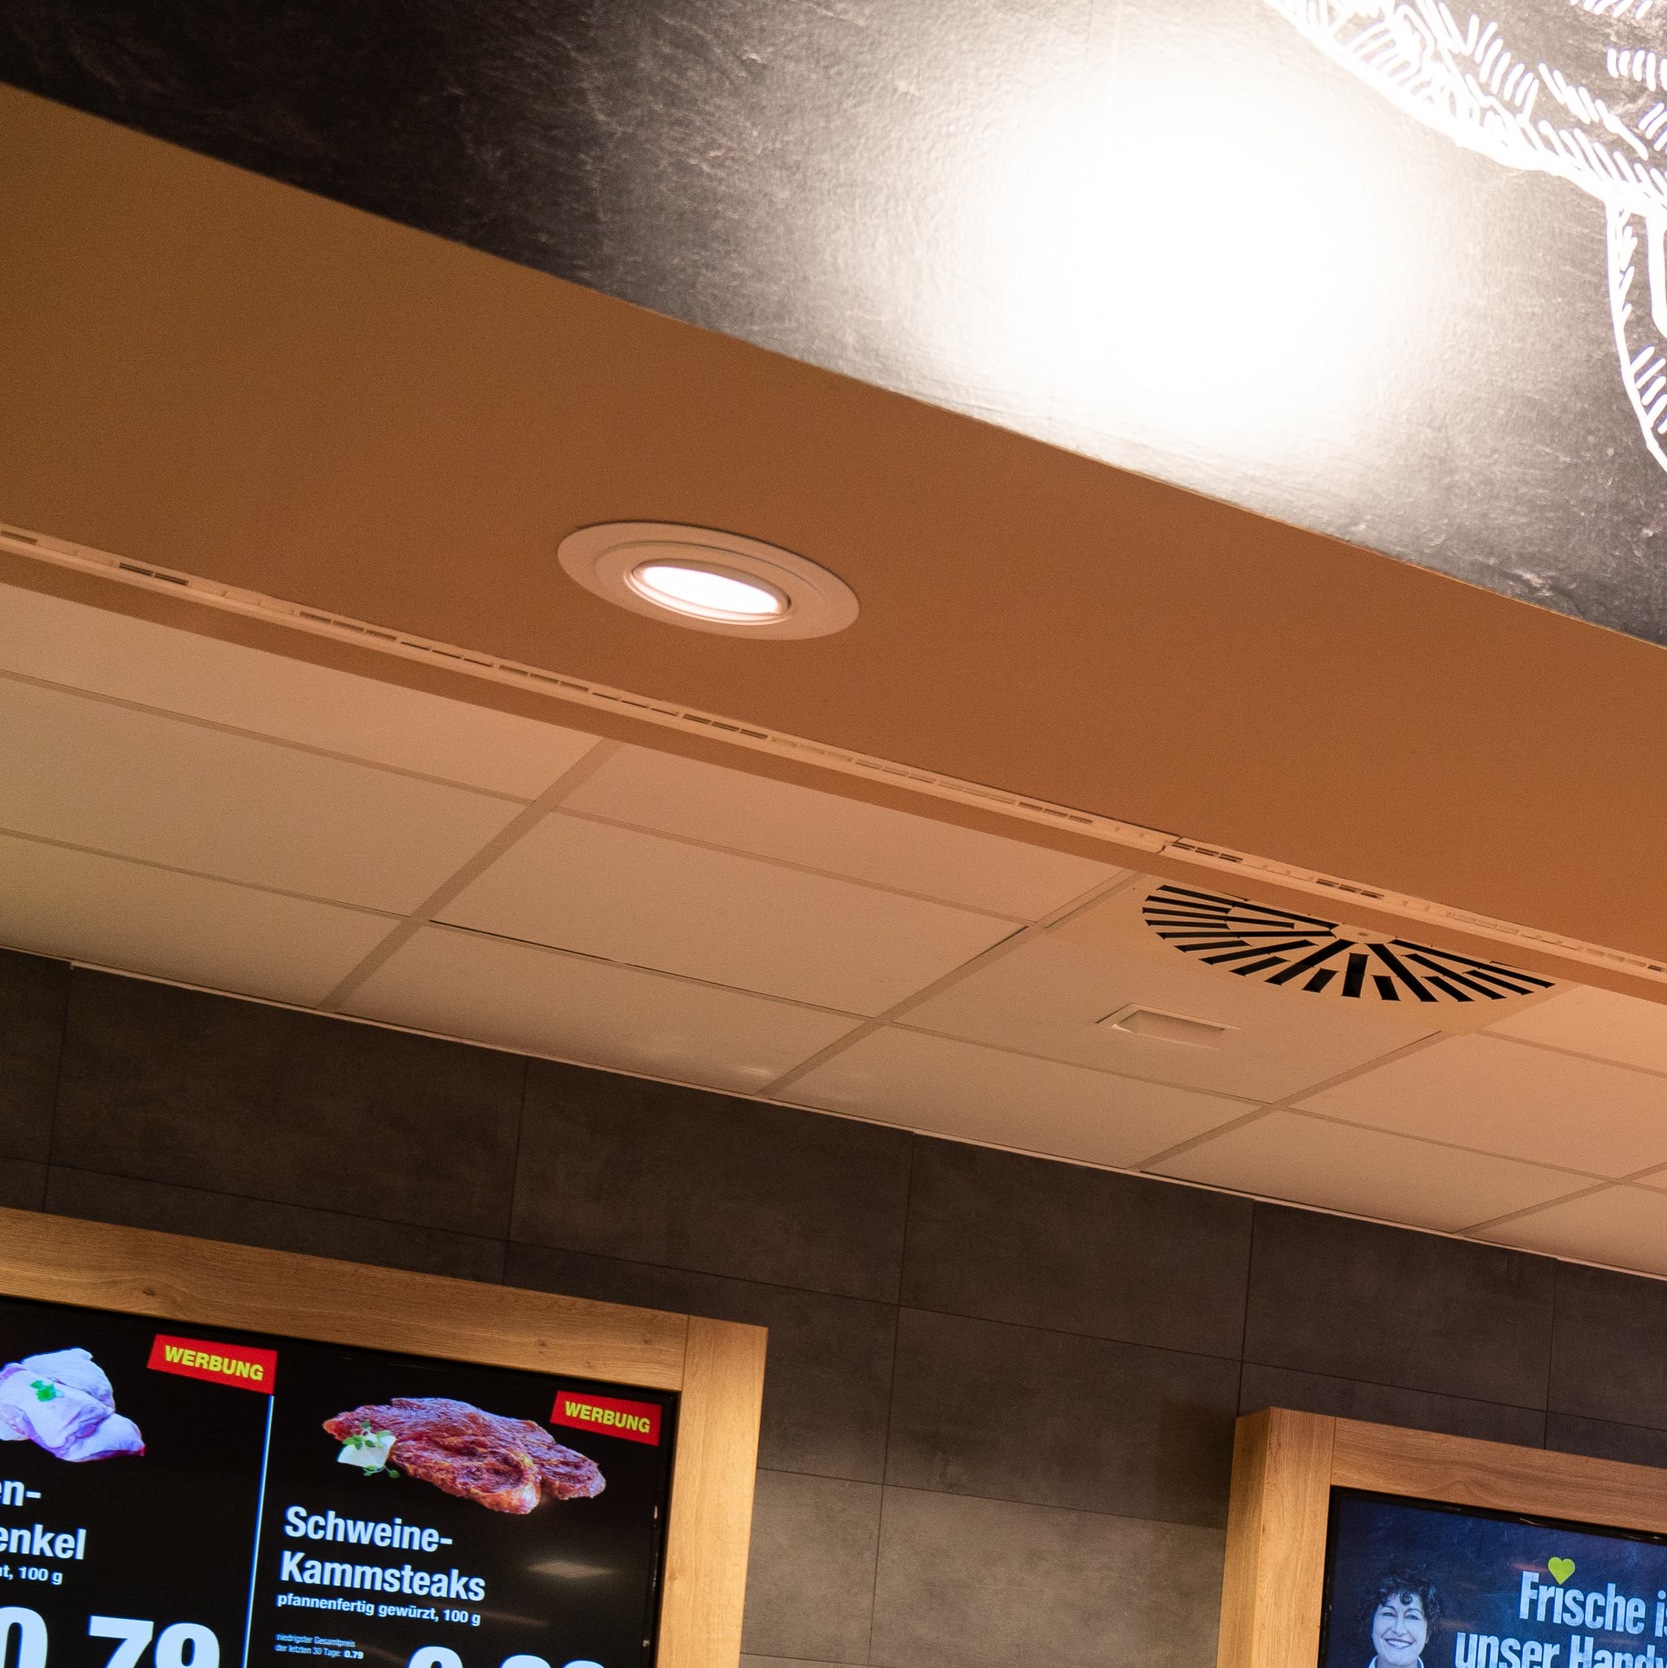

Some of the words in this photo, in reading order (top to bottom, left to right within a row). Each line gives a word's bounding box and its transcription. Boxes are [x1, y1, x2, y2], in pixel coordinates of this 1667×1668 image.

[164, 1345, 264, 1381] WERBUNG
[563, 1400, 652, 1435] WERBUNG
[284, 1506, 454, 1553] Schweine-
[18, 1566, 49, 1582] 100
[51, 1569, 63, 1586] g
[280, 1550, 487, 1602] Kammsteaks
[275, 1592, 376, 1617] pfannenfertig
[378, 1602, 440, 1623] gewürzt,
[442, 1608, 469, 1624] 100
[470, 1612, 482, 1627] g
[1518, 1570, 1646, 1635] Frische
